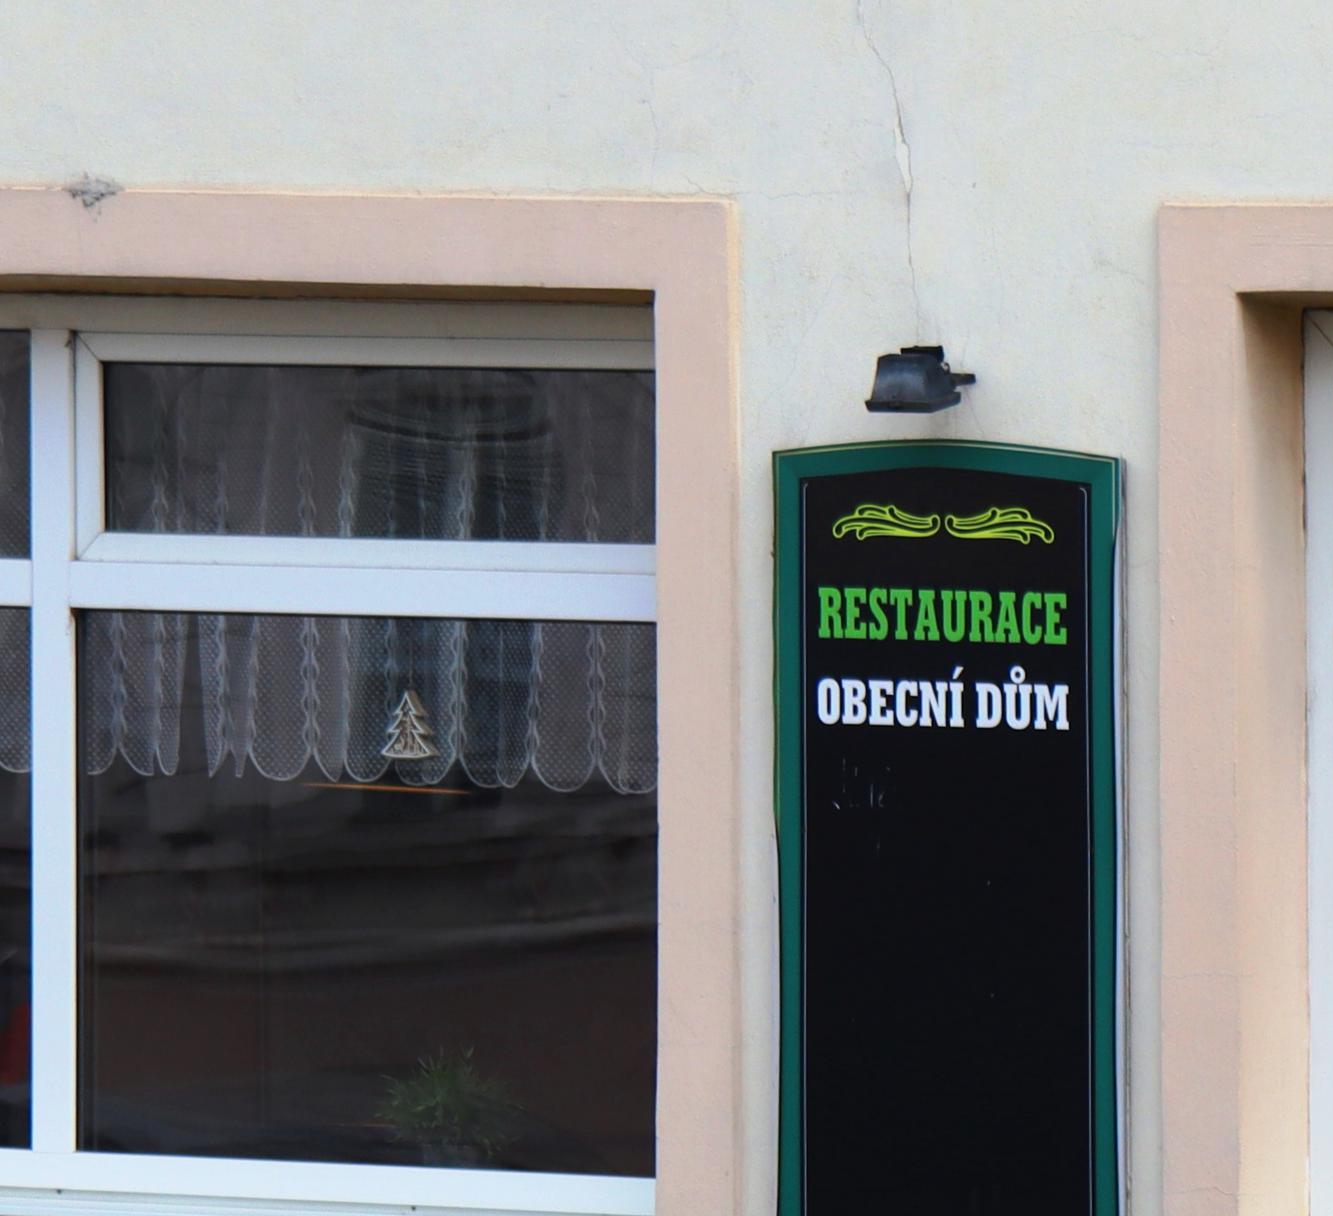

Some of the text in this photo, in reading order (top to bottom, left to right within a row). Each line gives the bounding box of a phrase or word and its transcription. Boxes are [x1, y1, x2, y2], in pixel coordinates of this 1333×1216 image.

[818, 587, 1067, 644] RESTAURACE
[817, 665, 1069, 730] OBECNÍ DŮM
